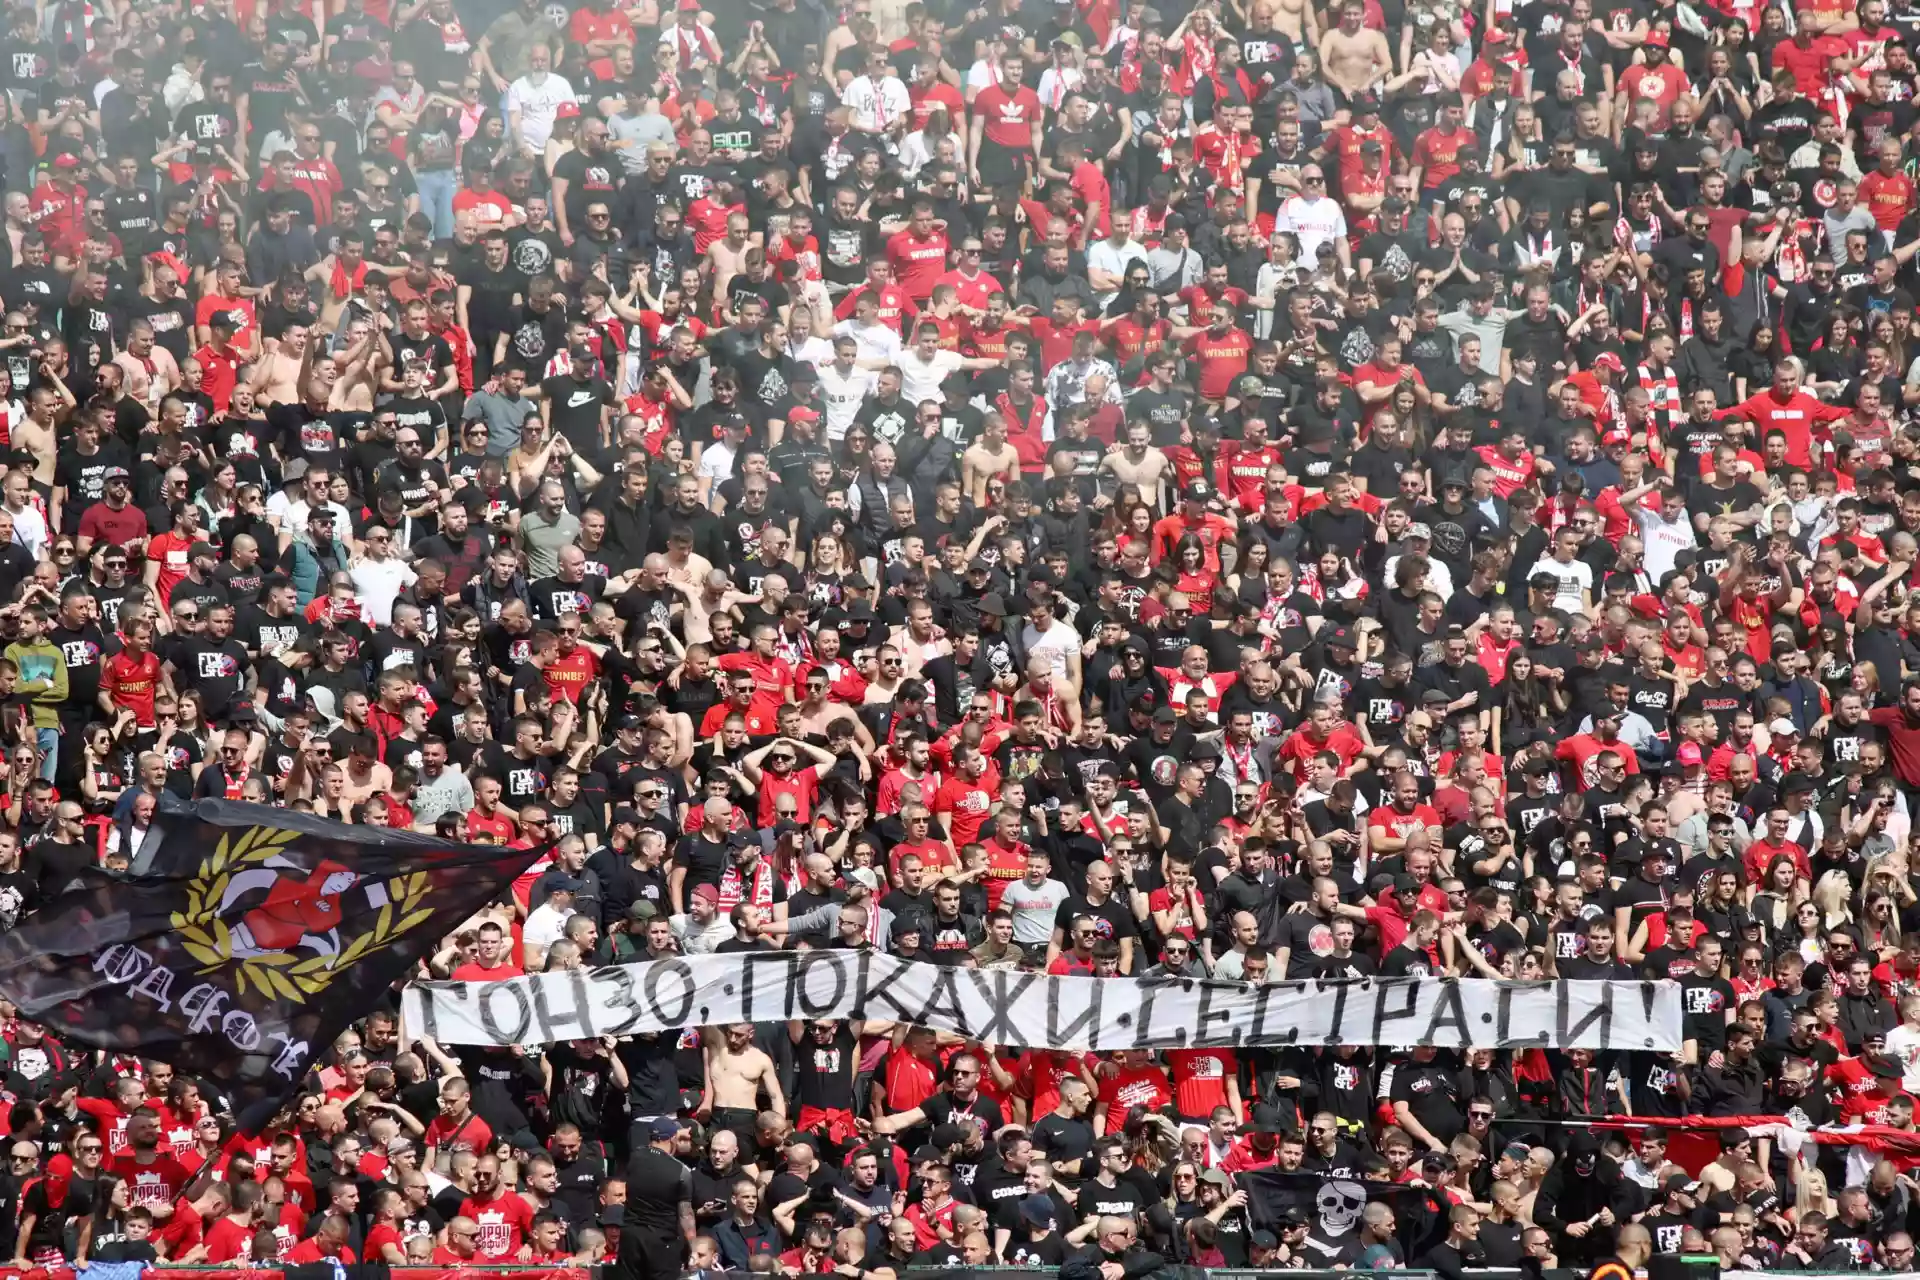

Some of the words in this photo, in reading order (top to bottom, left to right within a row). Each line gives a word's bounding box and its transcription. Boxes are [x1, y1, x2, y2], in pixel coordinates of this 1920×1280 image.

[196, 115, 219, 127] FCK
[1205, 347, 1244, 358] WINBET
[1232, 467, 1267, 477] WINBE
[1659, 534, 1689, 546] WINBE
[552, 591, 576, 606] FCK
[62, 641, 85, 654] FCK
[66, 653, 89, 668] LSFC
[198, 653, 223, 666] FCK
[199, 665, 225, 677] LSFC
[551, 671, 586, 681] WINBET
[1319, 668, 1343, 686] FCK
[1370, 699, 1393, 713] FCK
[1834, 737, 1859, 750] FCK
[510, 770, 533, 781] FCK
[510, 781, 534, 795] LSFC
[1521, 808, 1545, 821] FCK
[989, 868, 1027, 878] WINBET
[1557, 933, 1576, 946] FCK
[1557, 945, 1577, 958] LSFC
[742, 947, 1104, 1051] ПОКАЖИ
[1132, 976, 1474, 1048] СЕСТРА
[1686, 988, 1711, 1001] FCK
[1688, 1000, 1712, 1012] LSFC
[1657, 1225, 1683, 1238] FCK
